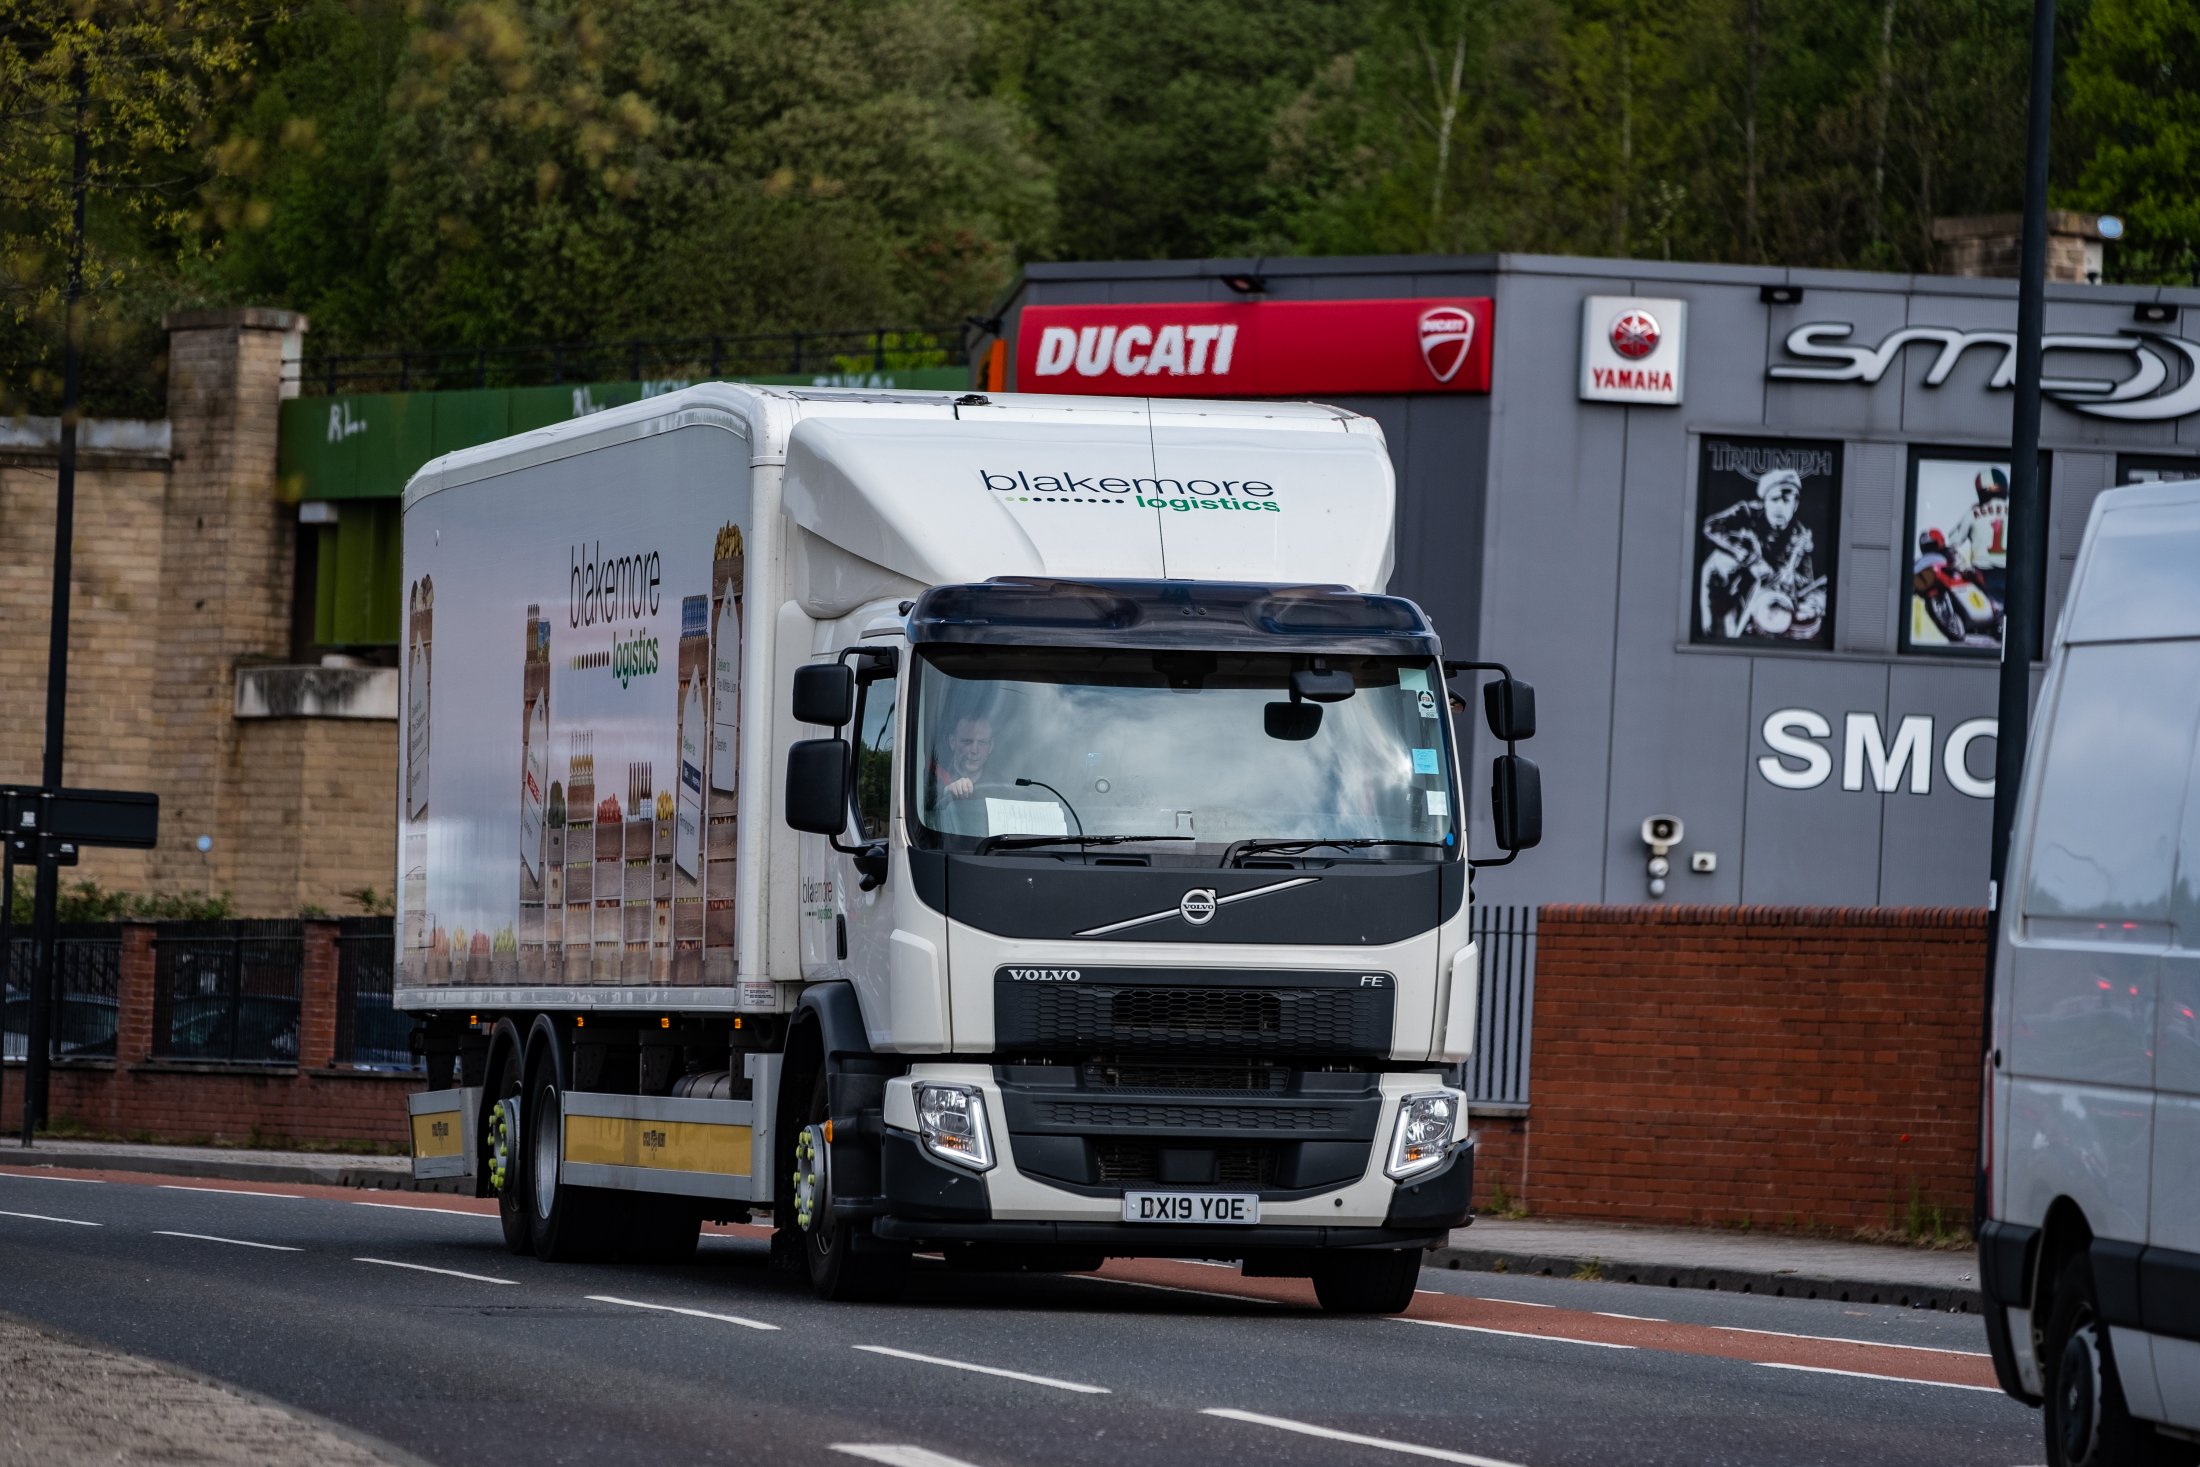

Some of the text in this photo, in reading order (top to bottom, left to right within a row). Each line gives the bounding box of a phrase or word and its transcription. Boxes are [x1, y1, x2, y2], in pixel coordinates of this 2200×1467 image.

[1035, 325, 1238, 376] DUCATI
[1592, 367, 1674, 392] YAMAHA
[1706, 441, 1833, 476] TRIUMPH
[980, 469, 1275, 497] blakemore
[1135, 495, 1281, 513] logistics
[569, 540, 661, 629] blakemore
[612, 627, 659, 690] logistics
[1008, 969, 1080, 981] VOLVO
[1360, 976, 1384, 987] FE
[1140, 1197, 1245, 1219] DX19 YOE
